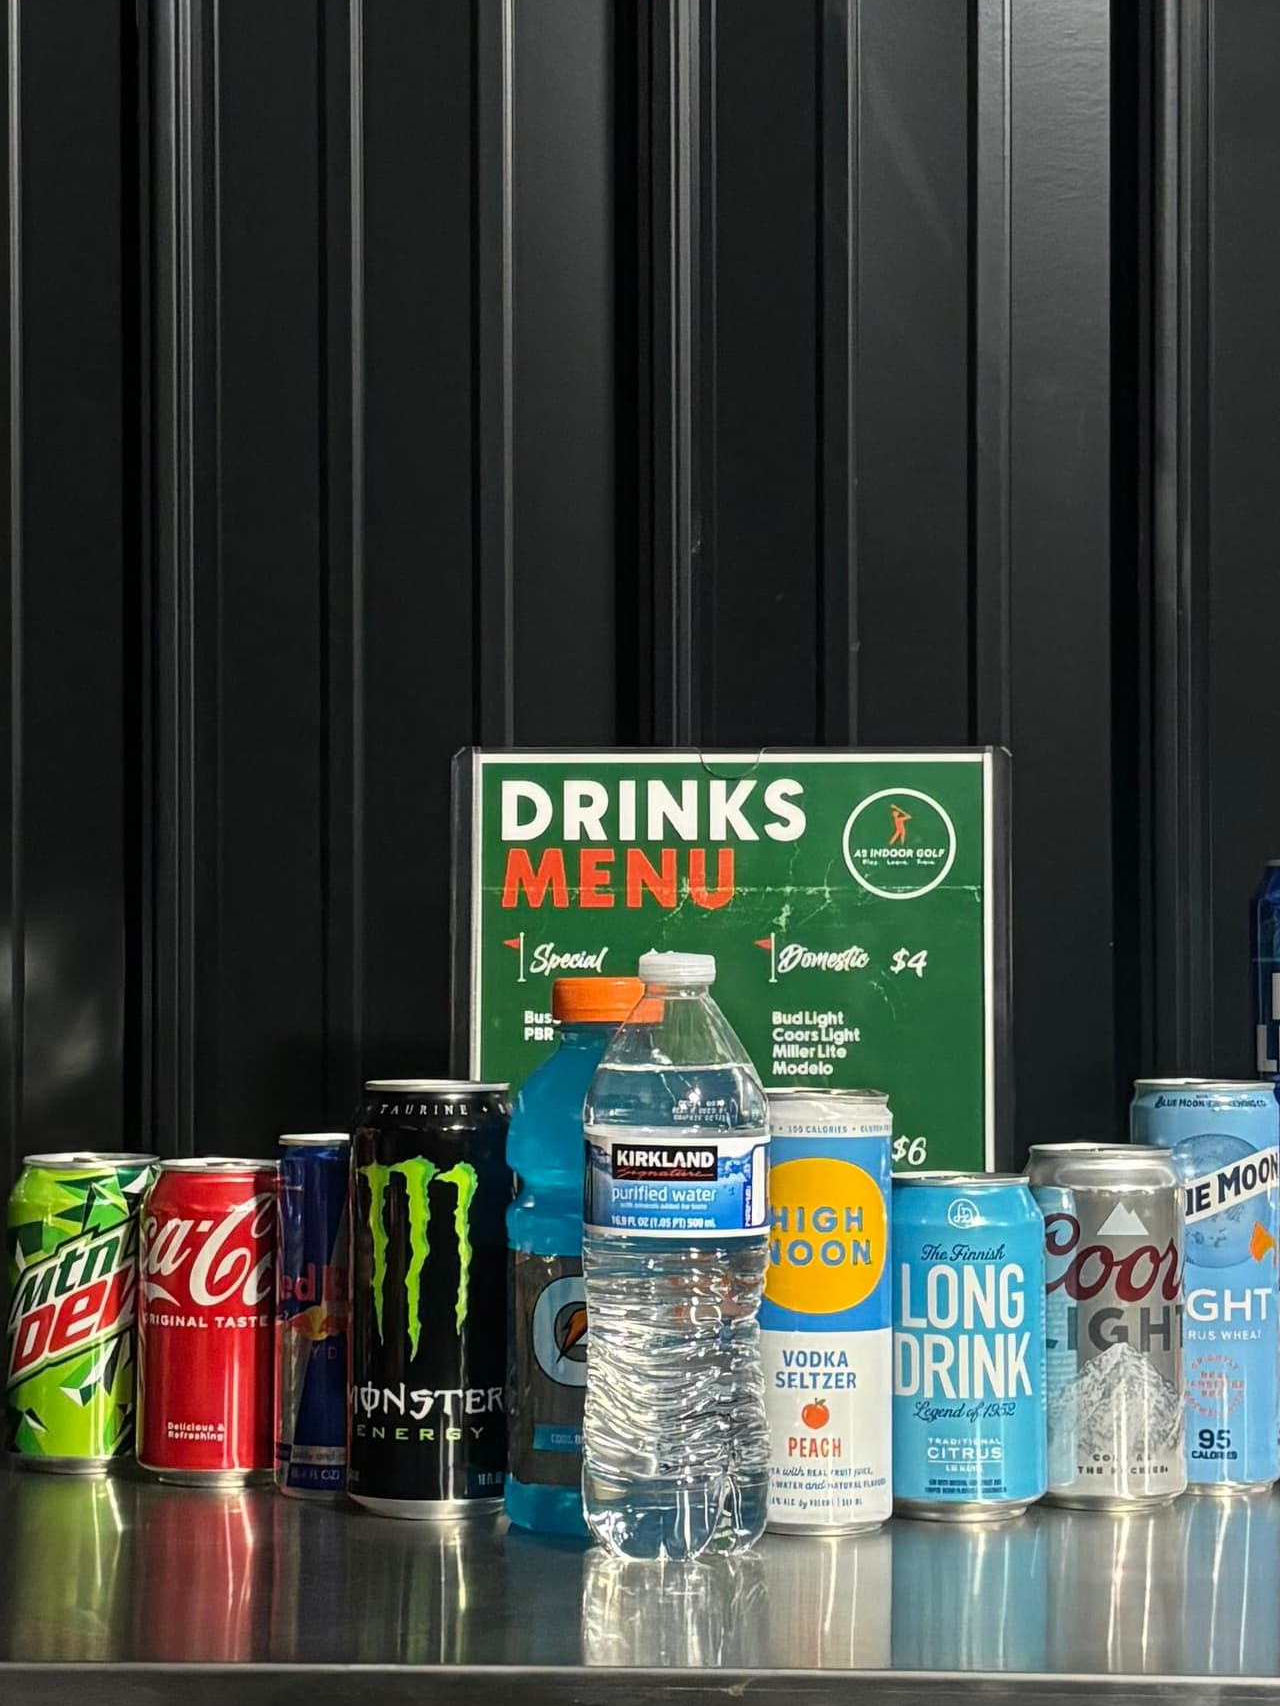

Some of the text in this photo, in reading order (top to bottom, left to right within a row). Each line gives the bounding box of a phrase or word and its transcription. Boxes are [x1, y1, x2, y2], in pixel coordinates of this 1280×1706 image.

[501, 779, 807, 841] DRINKS
[870, 849, 945, 858] INDOOR GOLF
[502, 848, 735, 910] MENU
[529, 943, 609, 974] Special
[776, 943, 928, 978] Domestic $4
[772, 1011, 844, 1028] Bud Light
[524, 1027, 554, 1041] PBR
[772, 1027, 860, 1044] Coors Light
[772, 1044, 847, 1059] Miller Lite
[772, 1060, 834, 1076] Modelo
[380, 1104, 468, 1115] TAURINE
[1155, 1096, 1205, 1109] BLUE MOON
[805, 1125, 848, 1134] CALORIES
[616, 1150, 715, 1169] KIRKLAND
[891, 1135, 928, 1167] $6
[617, 1167, 714, 1181] Signature
[1217, 1153, 1280, 1204] MOON
[612, 1185, 718, 1203] purified water
[628, 1215, 636, 1227] FL
[638, 1216, 649, 1228] OZ
[650, 1217, 671, 1229] (1.05
[687, 1217, 703, 1228] 500
[771, 1206, 864, 1232] HIGH
[920, 1243, 1007, 1262] The Finnish
[20, 1236, 121, 1316] Mtn
[902, 1263, 1024, 1329] LONG
[215, 1315, 269, 1328] TASTE
[782, 1349, 849, 1369] VODKA
[895, 1331, 1032, 1399] DRINK
[775, 1370, 857, 1390] SELTZER
[913, 1401, 1016, 1424] Legend of 1952
[168, 1422, 215, 1432] Delicious
[356, 1423, 485, 1441] ENERGY
[168, 1431, 224, 1442] Refreshing
[928, 1437, 1001, 1446] TRADITIONAL
[1198, 1429, 1231, 1449] 95
[788, 1437, 842, 1458] PEACH
[927, 1446, 1002, 1460] CITRUS
[783, 1466, 805, 1477] with
[1077, 1466, 1103, 1475] THE
[805, 1479, 825, 1490] and
